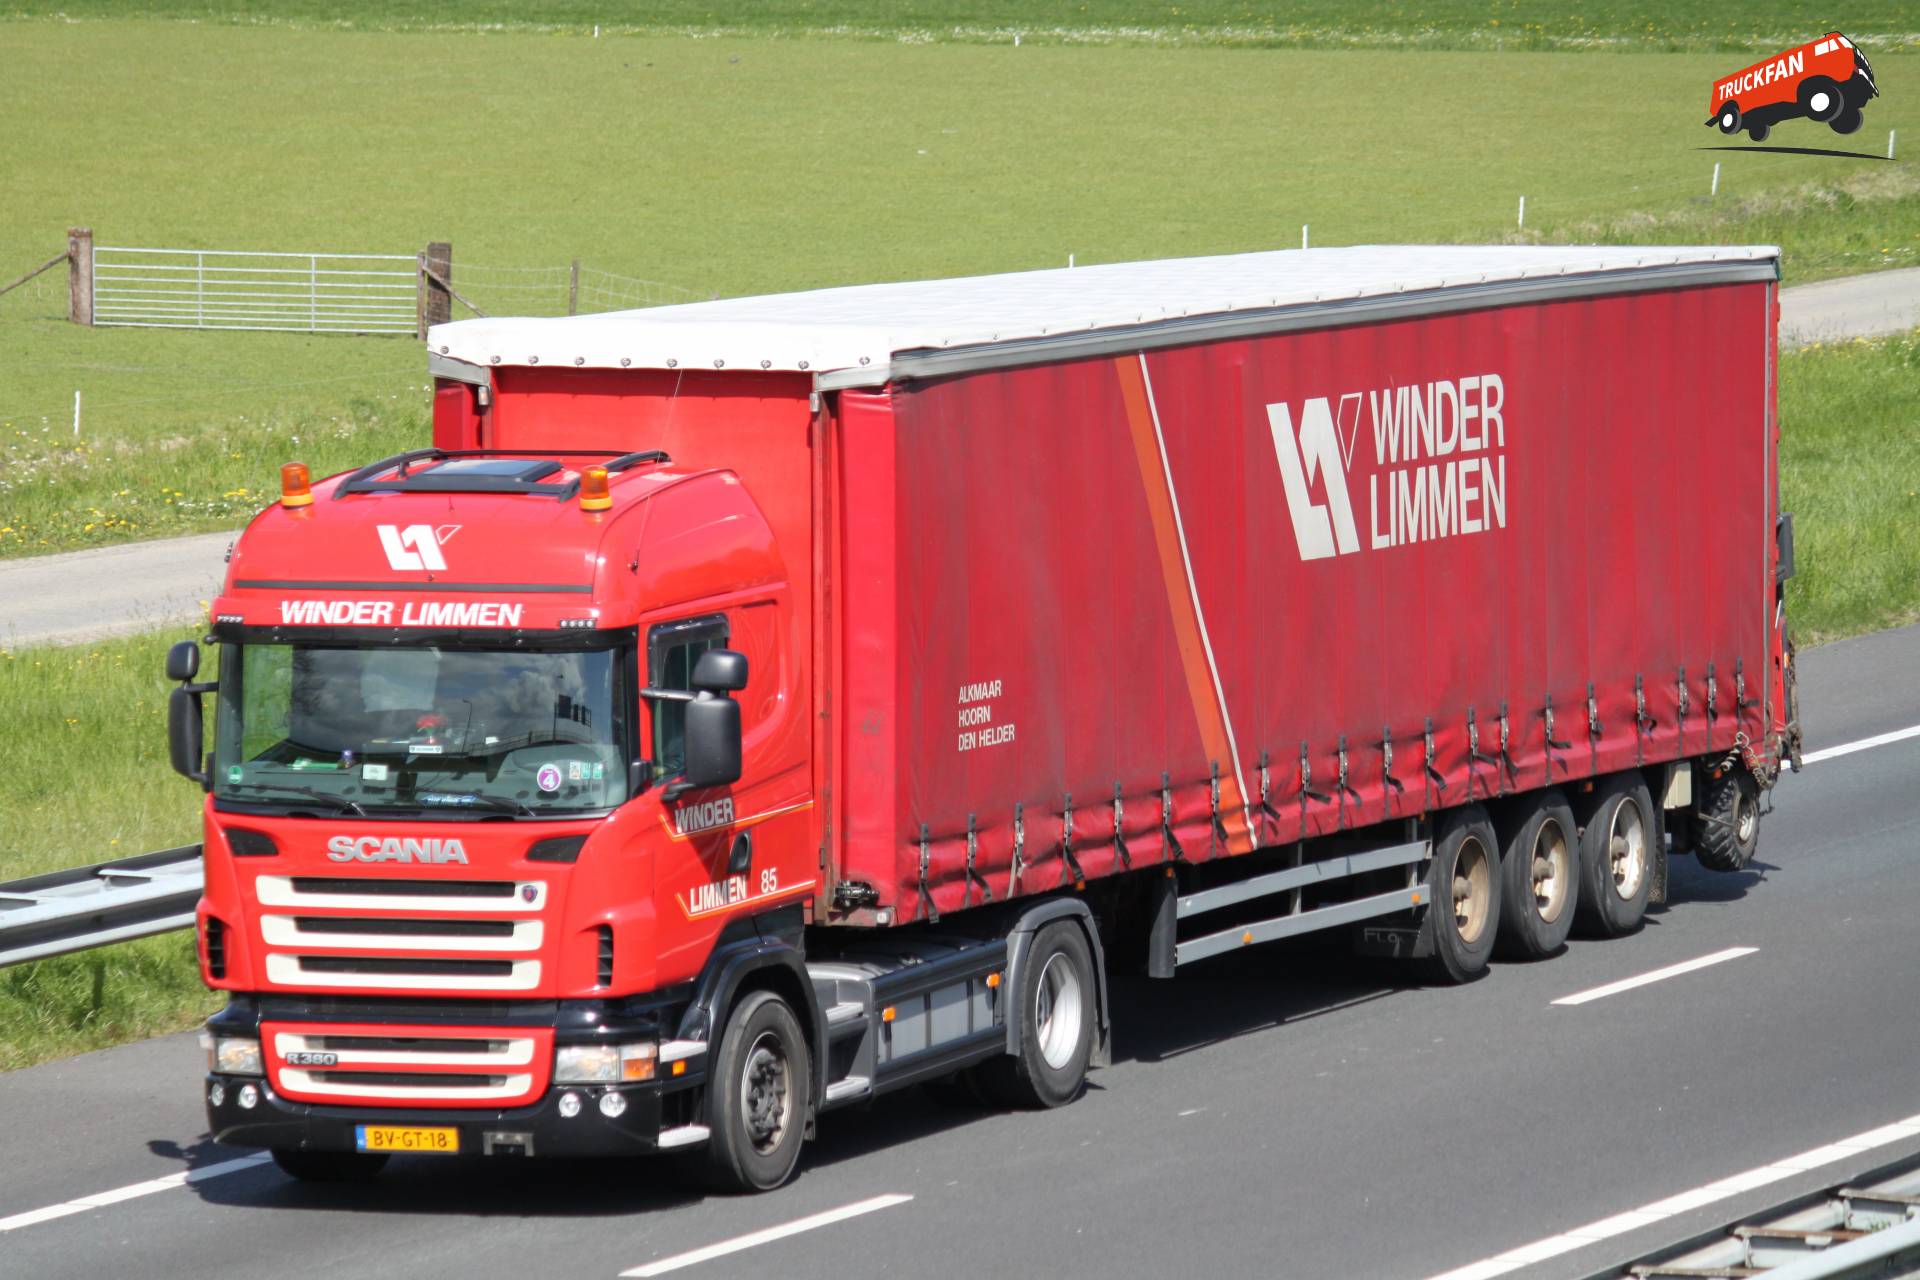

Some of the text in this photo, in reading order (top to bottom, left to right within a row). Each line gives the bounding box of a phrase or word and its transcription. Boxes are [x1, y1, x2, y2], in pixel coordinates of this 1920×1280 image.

[1370, 373, 1505, 465] WINDER
[1370, 455, 1506, 550] LIMMEN
[281, 600, 522, 626] WINDER LIMMEN
[958, 680, 1002, 704] ALKMAAR
[958, 705, 991, 728] HOORN
[958, 723, 1015, 752] DEN HELDER
[675, 797, 734, 833] WINDER
[327, 835, 469, 865] SCANIA
[690, 867, 777, 913] LIMMEN 85
[373, 1130, 447, 1148] BV-GT-18
